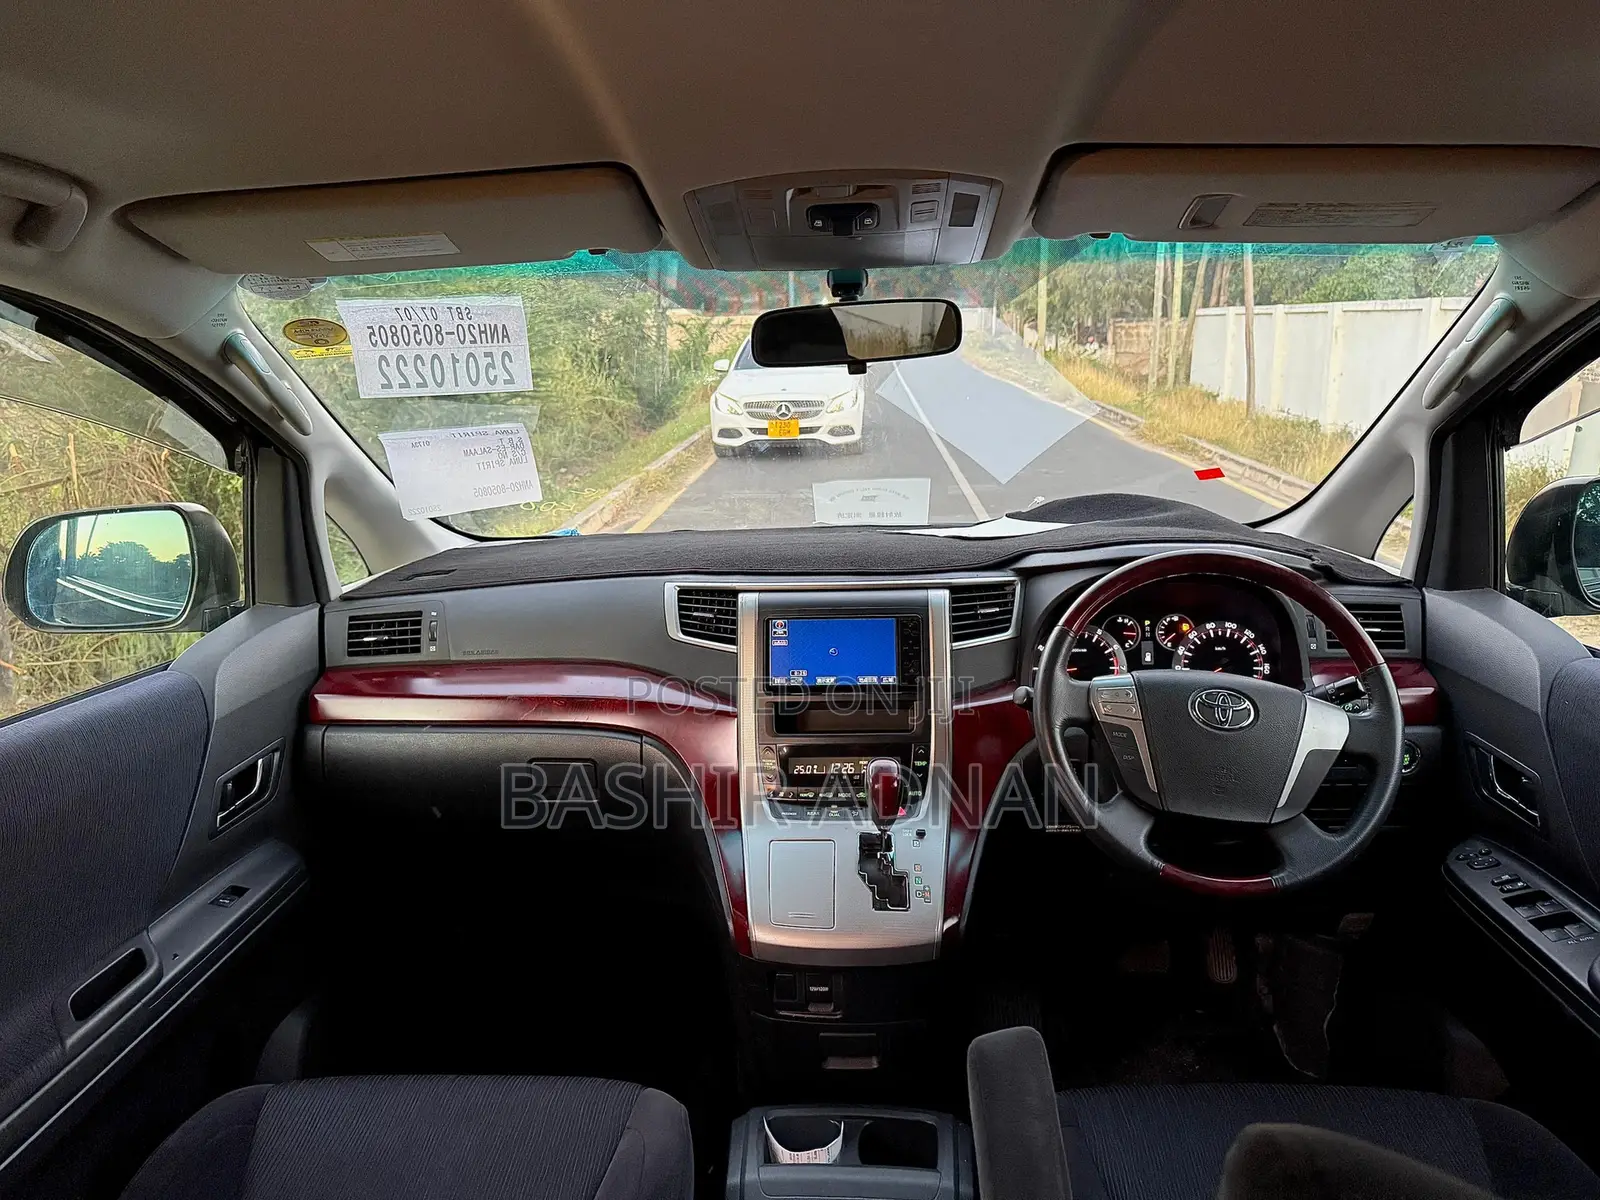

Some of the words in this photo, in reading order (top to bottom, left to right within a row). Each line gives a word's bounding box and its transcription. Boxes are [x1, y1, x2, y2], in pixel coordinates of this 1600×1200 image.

[1205, 622, 1216, 630] 80
[1224, 621, 1238, 630] 100
[1188, 630, 1198, 640] 60
[1244, 628, 1256, 639] 120
[1177, 645, 1185, 656] 40
[1257, 643, 1267, 655] 140
[1263, 663, 1271, 675] 160
